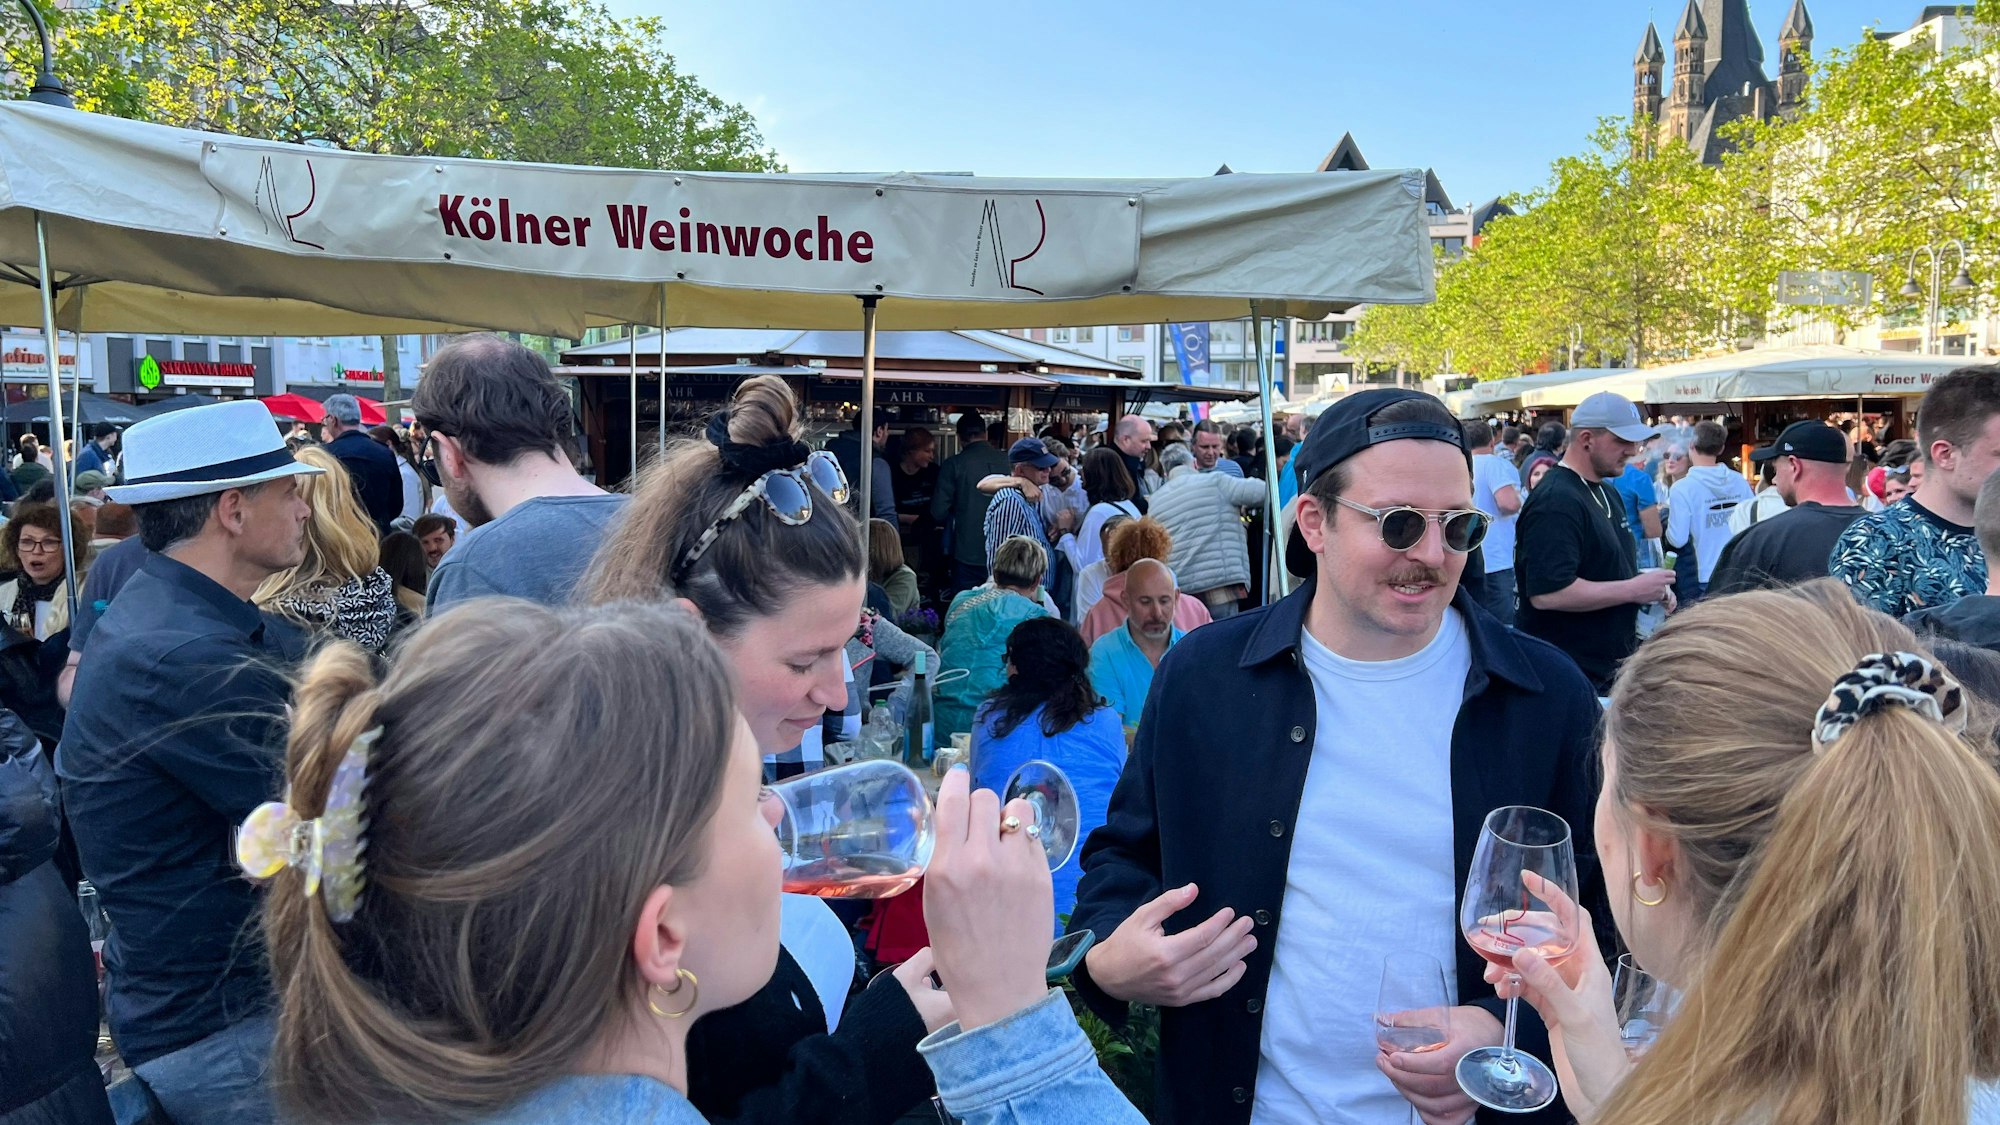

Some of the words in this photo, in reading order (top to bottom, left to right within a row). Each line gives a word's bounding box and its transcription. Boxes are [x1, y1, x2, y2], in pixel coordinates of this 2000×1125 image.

[439, 194, 591, 247] Kölner
[607, 204, 874, 263] Weinwoche
[220, 363, 255, 377] BHAVAN
[1874, 373, 1917, 385] Kölner
[890, 391, 927, 403] AHR
